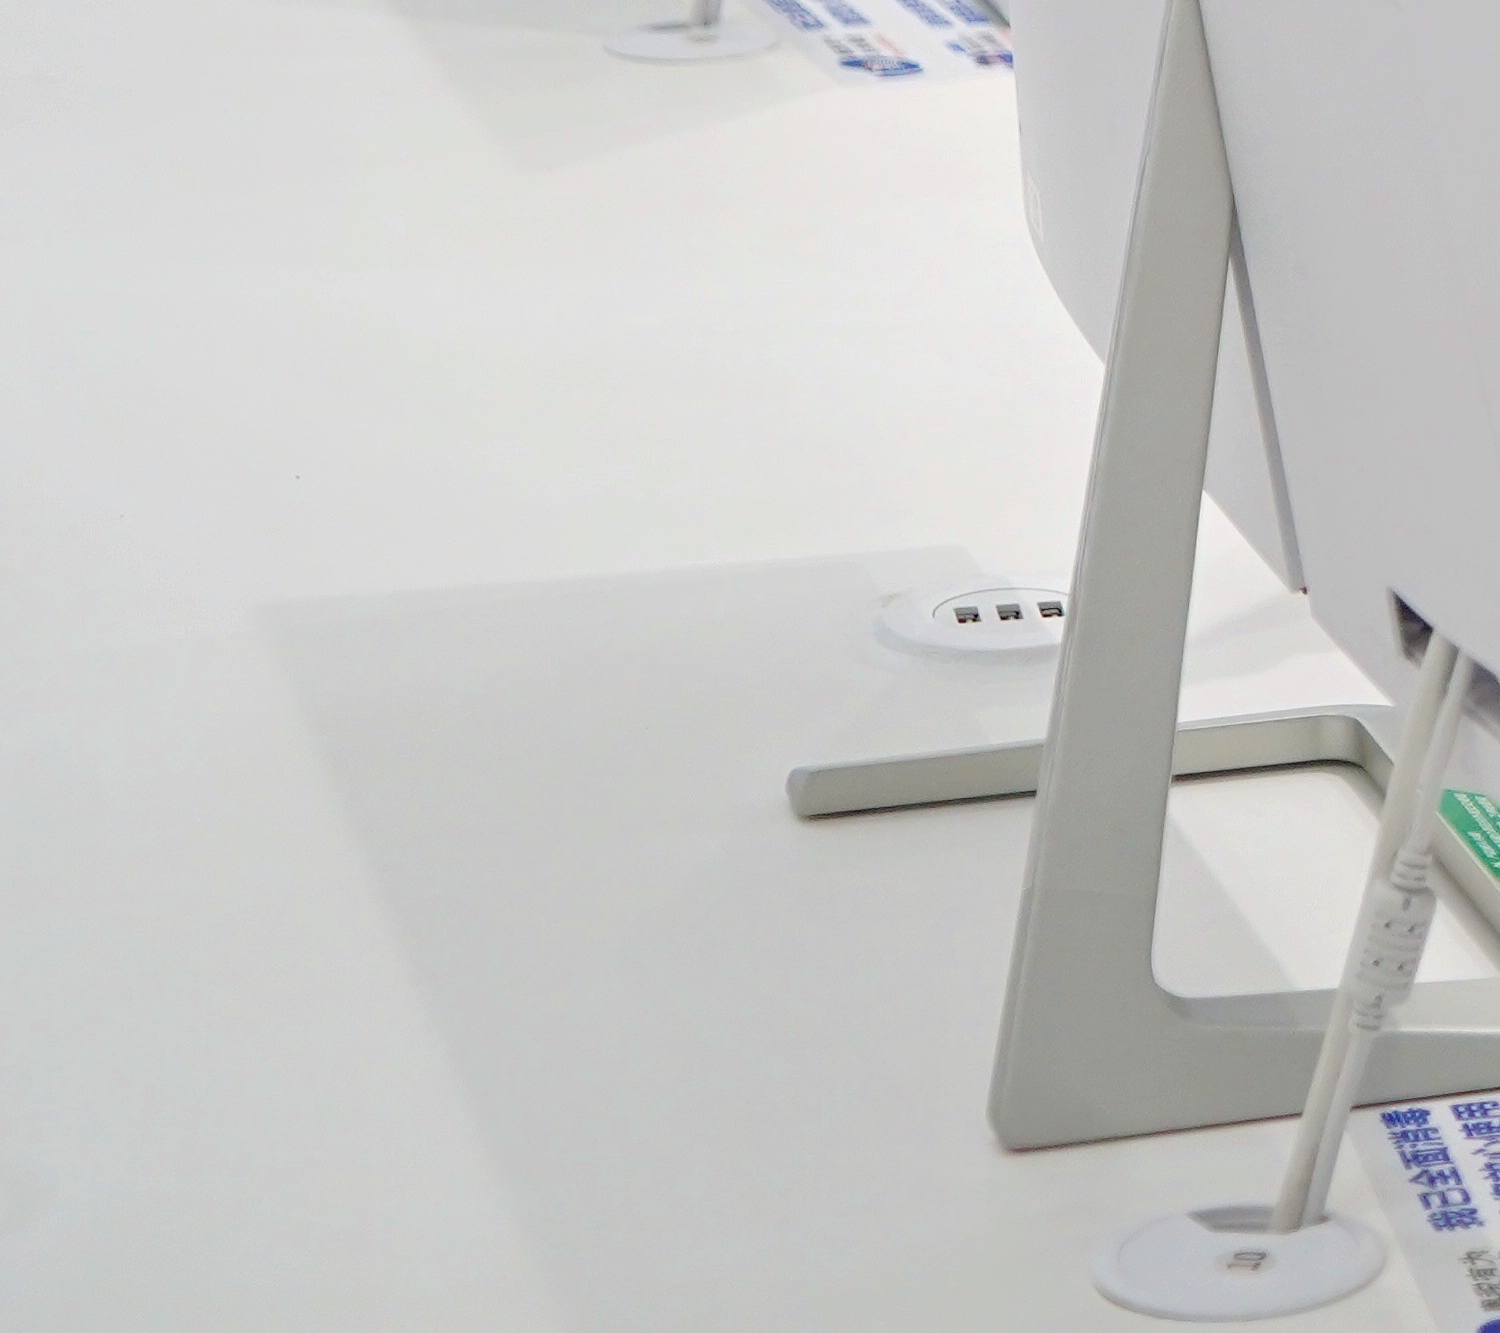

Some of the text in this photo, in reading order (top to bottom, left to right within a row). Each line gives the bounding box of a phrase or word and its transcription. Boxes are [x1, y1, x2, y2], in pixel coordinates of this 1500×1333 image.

[1380, 1106, 1484, 1232] 我已全面消毒
